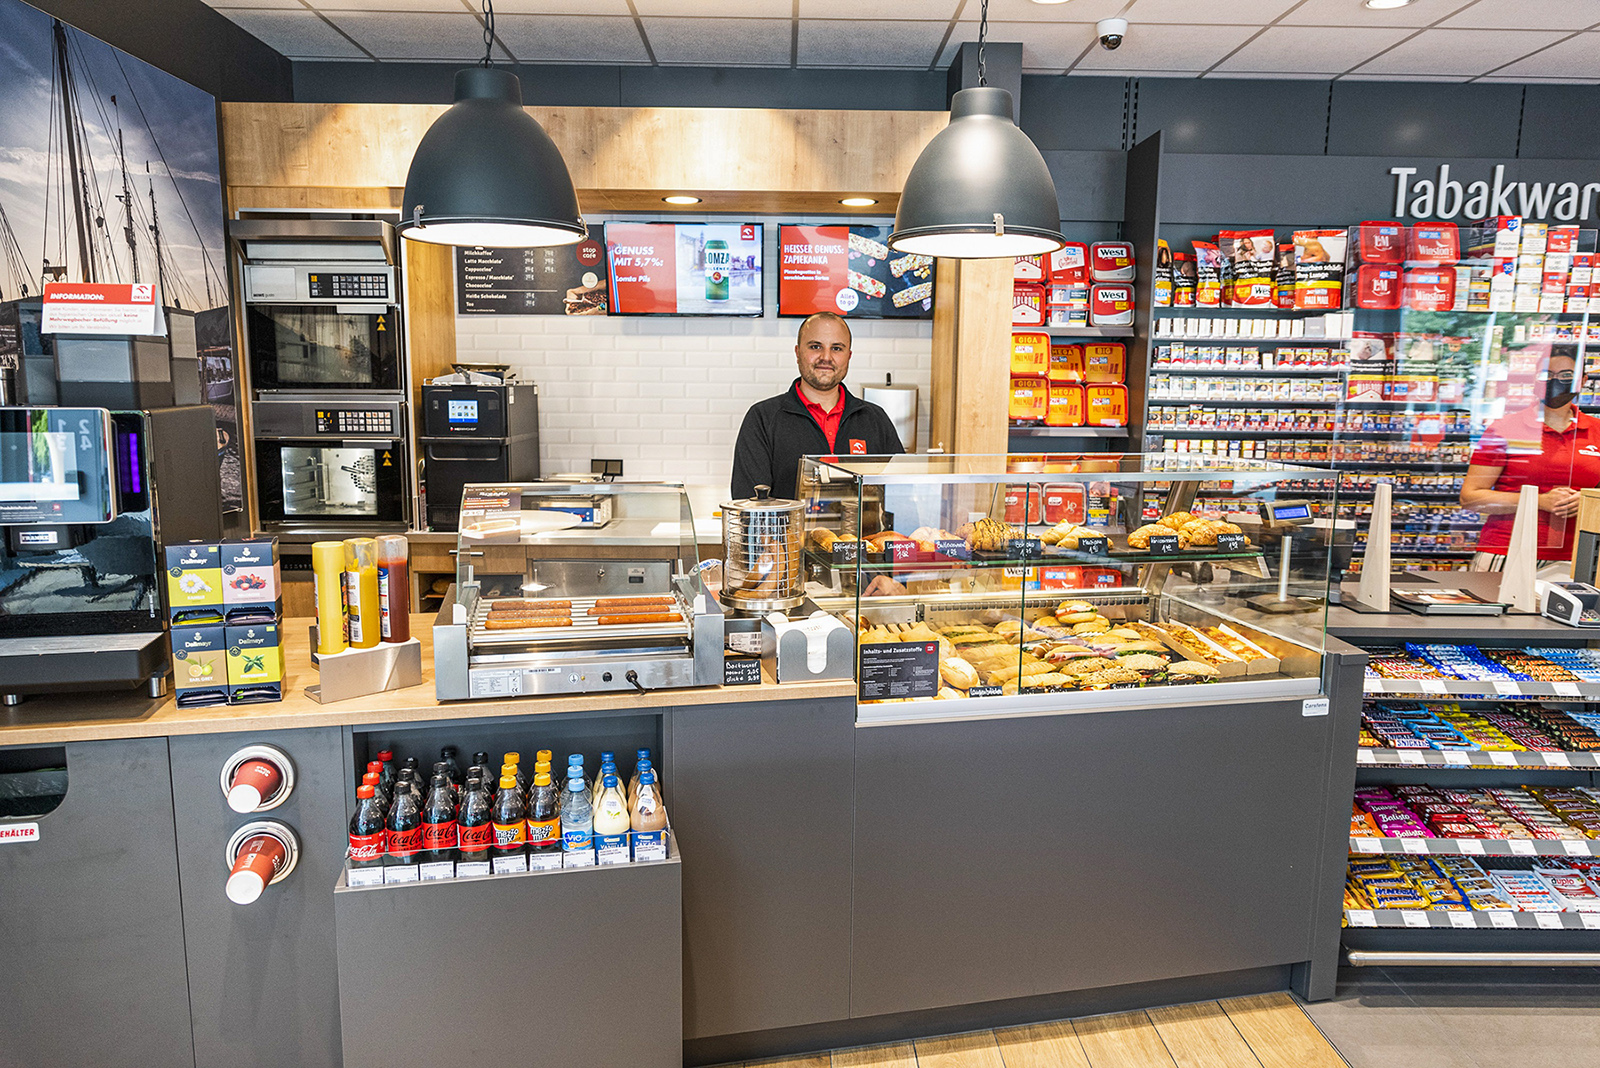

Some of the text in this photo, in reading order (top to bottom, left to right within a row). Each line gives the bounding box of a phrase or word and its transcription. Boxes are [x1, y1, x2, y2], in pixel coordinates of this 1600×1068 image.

[614, 246, 654, 255] GENUSS
[784, 245, 844, 254] HEISSER GENUSS:
[1418, 244, 1450, 256] Winston
[614, 257, 664, 268] MIT 5,7%:
[784, 255, 828, 264] ZAPIEKANKA
[50, 293, 104, 301] INFORMATION:
[1101, 291, 1126, 299] West
[1415, 289, 1446, 301] Winston
[1018, 380, 1037, 388] GIGA
[181, 558, 207, 566] Dallmayr
[185, 640, 212, 648] Dallmayr
[238, 637, 264, 645] Dallmayr
[863, 647, 882, 655] Inhalts-
[1379, 814, 1411, 823] Balisto
[496, 828, 519, 838] mezzo
[530, 824, 553, 835] mezzo
[1392, 829, 1424, 838] Balisto
[498, 836, 515, 846] mix
[533, 832, 550, 842] mix
[1551, 878, 1575, 887] duplo
